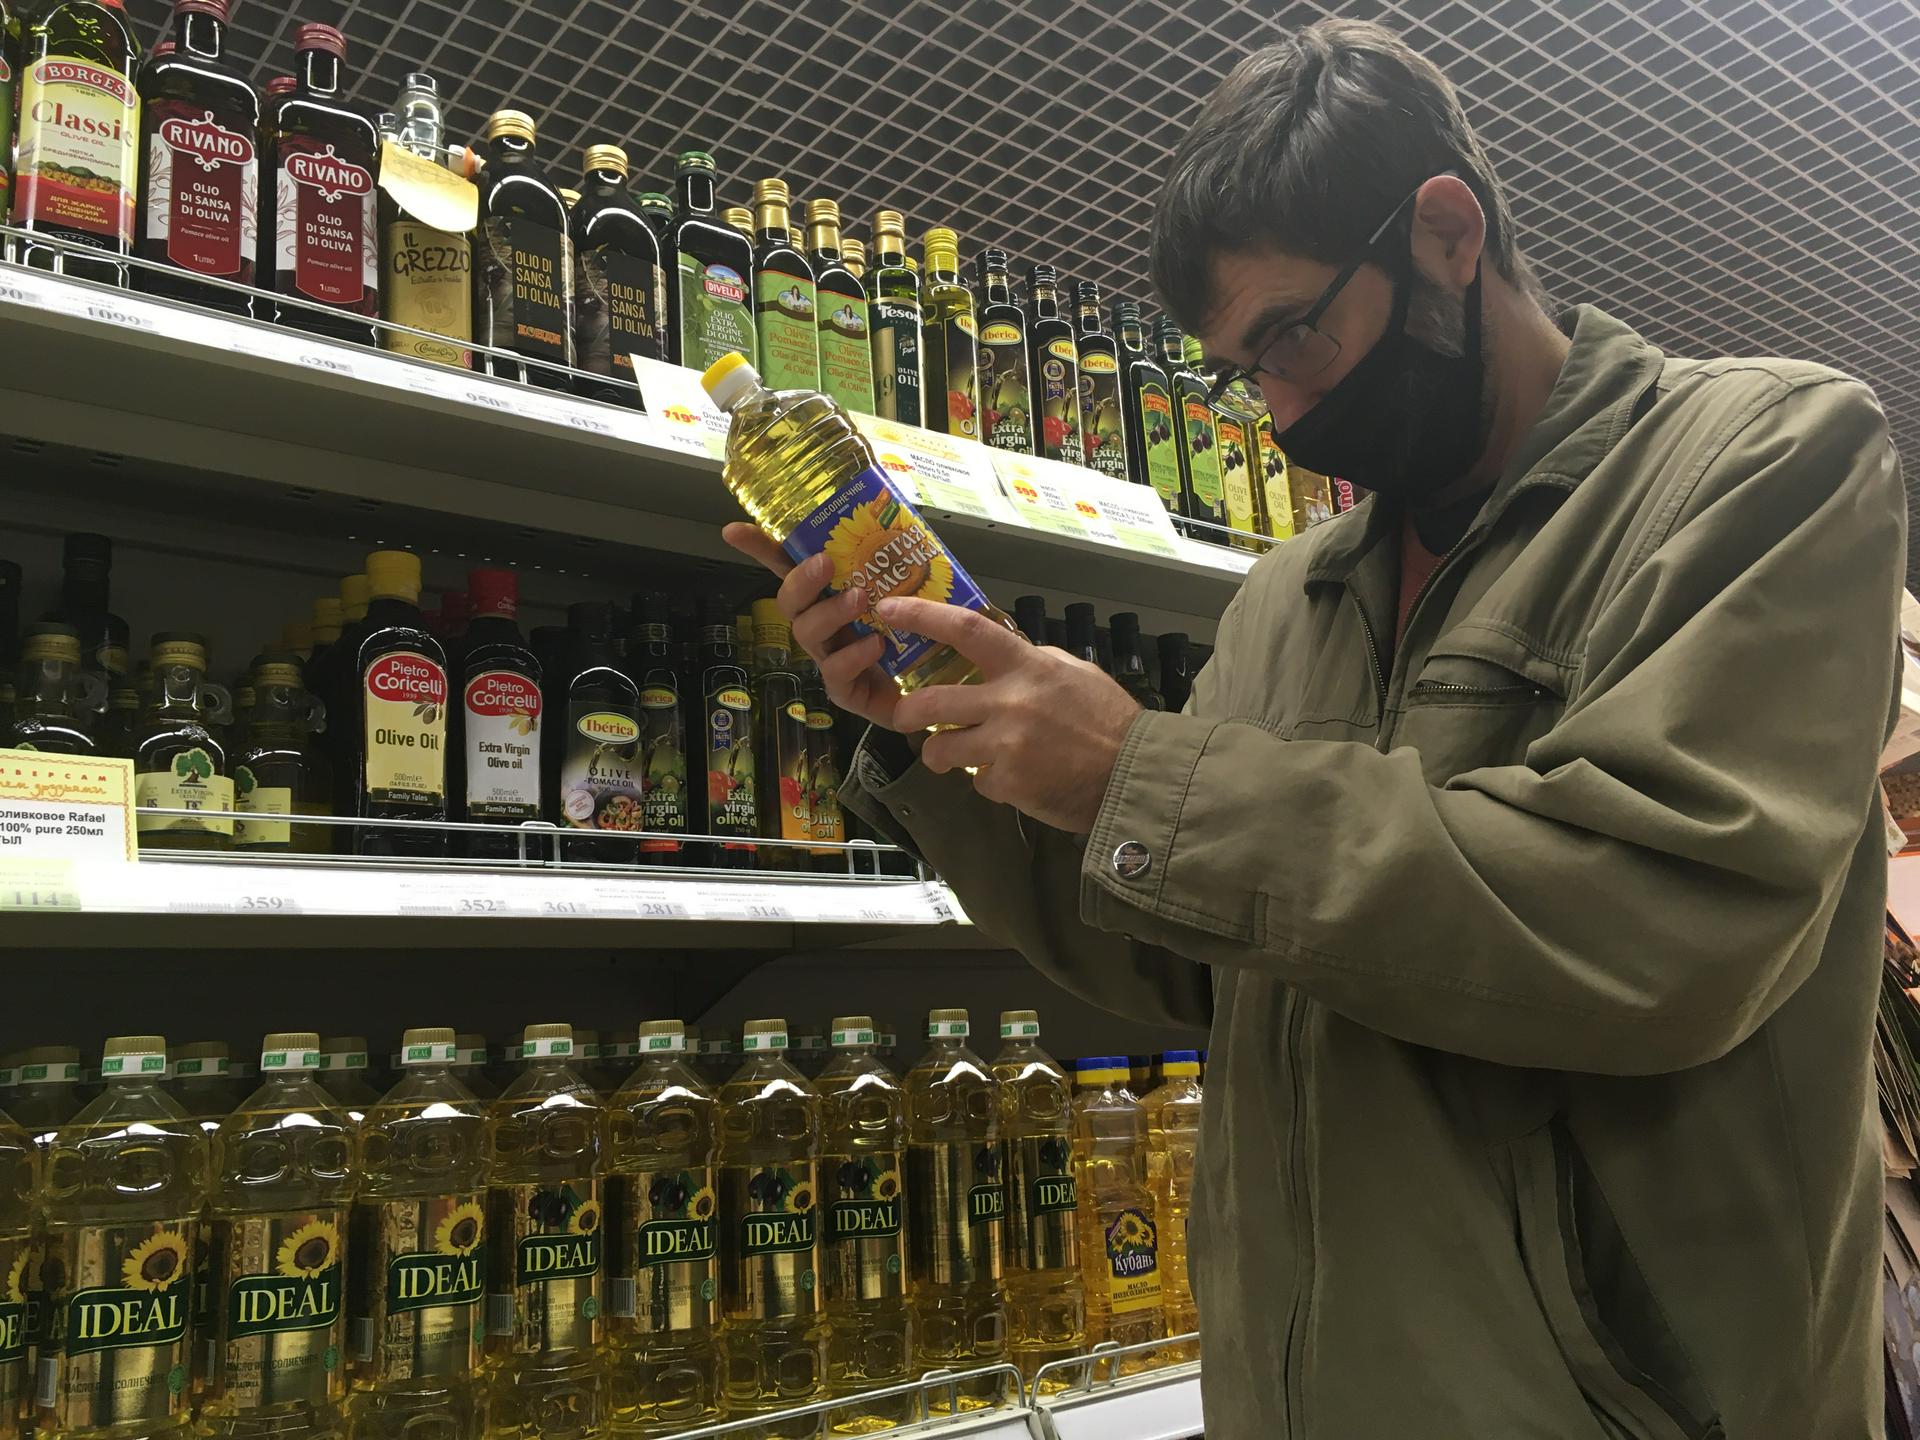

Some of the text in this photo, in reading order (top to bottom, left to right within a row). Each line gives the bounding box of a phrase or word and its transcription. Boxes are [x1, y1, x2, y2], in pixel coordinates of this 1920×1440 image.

[48, 65, 126, 95] BORGES
[32, 100, 133, 148] Classic
[170, 125, 243, 157] RIVANO
[295, 158, 363, 188] RIVANO
[193, 182, 220, 196] OLIO
[50, 195, 68, 204] ДЛЯ
[180, 192, 231, 211] DI SANSA
[181, 205, 230, 223] DI OLIVA
[317, 214, 342, 226] OLIO
[306, 223, 354, 241] DI SANSA
[307, 235, 352, 253] DI OLIVA
[403, 232, 418, 248] IL
[193, 254, 198, 262] 1
[393, 246, 471, 276] GREZZO
[516, 250, 552, 273] OLIO DI
[516, 267, 552, 290] SANSA
[516, 285, 560, 309] DI OLIVA
[611, 283, 645, 305] OLIO DI
[708, 282, 740, 299] DIVELLA
[612, 300, 645, 320] SANSA
[713, 309, 734, 321] OLIO
[612, 316, 653, 338] DI OLIVA
[705, 321, 743, 338] VERGINE
[710, 315, 737, 329] EXTRA
[707, 329, 716, 337] DI
[718, 332, 743, 345] OLIVA
[769, 332, 808, 350] Pomace
[784, 325, 810, 342] Olive
[984, 329, 1018, 341] Ibérica
[772, 349, 790, 360] Olio
[824, 350, 860, 366] Pomace
[838, 343, 863, 358] Olive
[794, 365, 814, 376] Oliva
[1084, 358, 1115, 370] Ibérica
[827, 367, 844, 378] Olio
[897, 367, 919, 378] OLIVE
[897, 376, 919, 388] OIL
[991, 422, 1024, 434] Extra
[989, 433, 1027, 448] virgin
[1092, 448, 1122, 459] Extra
[1090, 458, 1124, 471] virgin
[1228, 483, 1248, 496] OLIVE
[810, 480, 867, 528] ПОДСОЛНЕЧНОЕ
[1232, 493, 1245, 503] OIL
[1269, 492, 1288, 503] OLIVE
[1273, 500, 1286, 510] OIL
[866, 539, 939, 605] ЕМЕЧКА
[391, 661, 429, 677] Pietro
[375, 673, 442, 695] Coricelli
[487, 679, 524, 693] Pietro
[472, 690, 537, 709] Coricelli
[587, 719, 634, 736] Ibérica
[375, 728, 439, 750] Olive Oil
[479, 741, 530, 757] Extra Virgin
[487, 757, 523, 769] Olive oil
[589, 767, 632, 780] OLIVE
[622, 780, 635, 789] OIL
[388, 791, 428, 801] Family Tales
[727, 788, 754, 802] Extra
[485, 805, 524, 814] Family Tales
[723, 801, 755, 817] virgin
[69, 812, 106, 823] Rafael
[644, 815, 684, 827] ive oil
[716, 813, 748, 825] olive
[0, 822, 104, 836] 100% pure 250мл
[816, 826, 835, 839] oil
[15, 891, 59, 905] 114
[242, 896, 284, 910] 359
[459, 899, 497, 912] 352
[642, 903, 674, 915] 281
[750, 905, 778, 918] 314
[1039, 1183, 1076, 1206] IDEA
[836, 1205, 898, 1233] IDEAL
[646, 1225, 713, 1255] IDEAL
[747, 1218, 812, 1247] IDEAL
[525, 1240, 597, 1273] IDEAL
[1115, 1250, 1154, 1275] Кубань
[398, 1259, 482, 1299] IDEAL
[1127, 1282, 1148, 1291] МАСЛО
[238, 1282, 335, 1323] IDEAL
[78, 1295, 183, 1339] IDEAL
